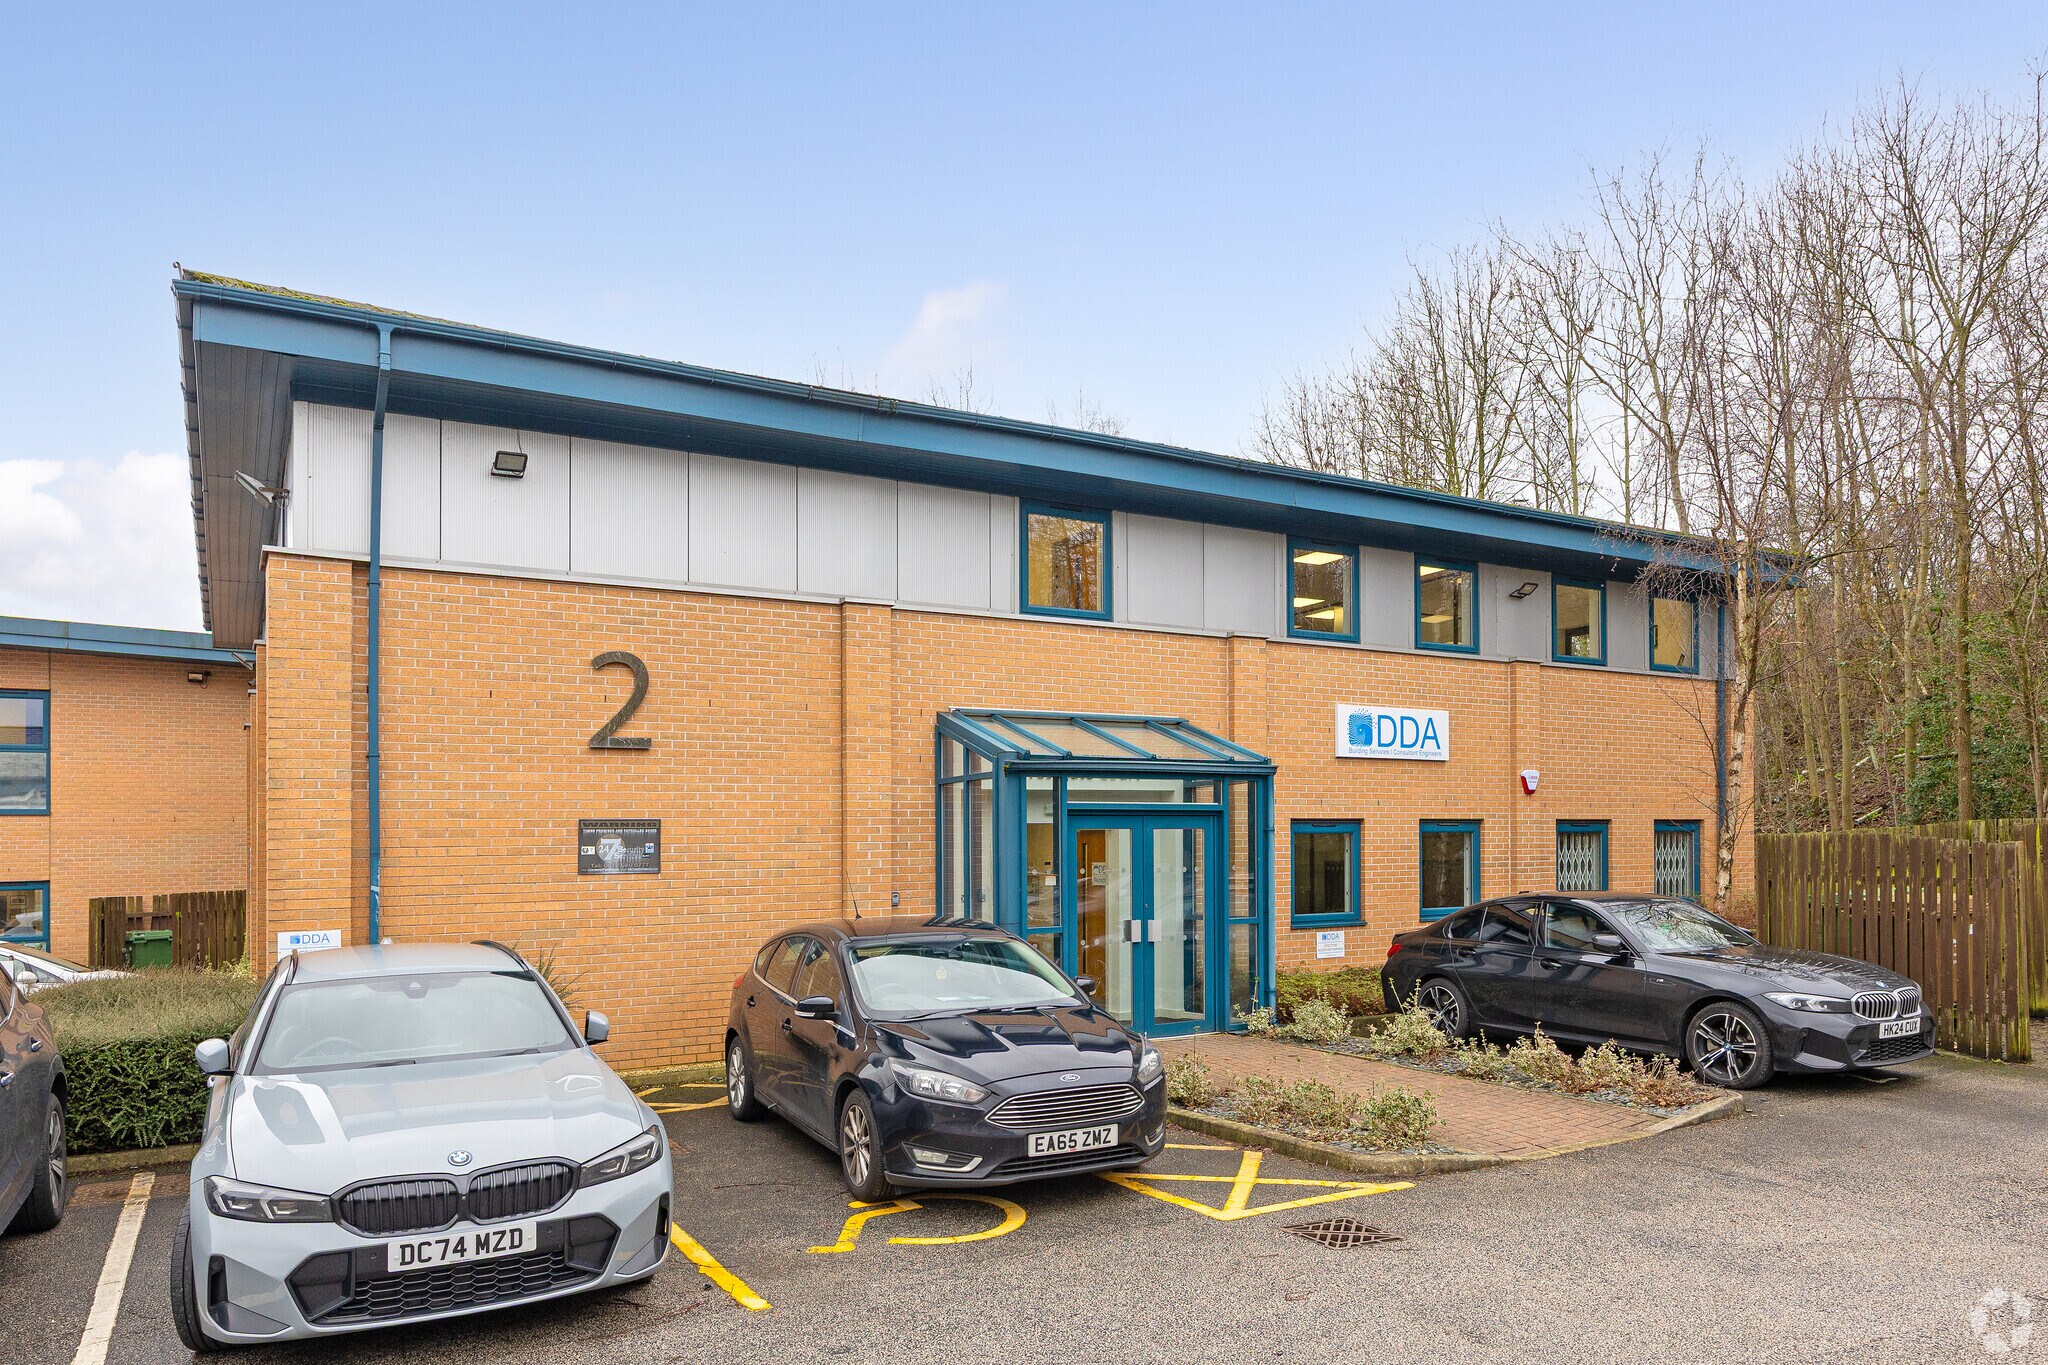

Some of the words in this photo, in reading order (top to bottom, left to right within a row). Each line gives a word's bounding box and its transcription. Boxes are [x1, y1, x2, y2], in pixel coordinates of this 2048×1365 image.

[590, 650, 652, 749] 2
[1377, 714, 1441, 750] DDA
[1348, 747, 1369, 756] Building
[1393, 748, 1418, 756] Consultant
[302, 933, 330, 944] DDA
[1883, 1022, 1904, 1036] HK24
[1904, 1020, 1918, 1033] CUX
[1034, 1132, 1078, 1153] EA65
[1082, 1128, 1112, 1148] ZMZ
[400, 1236, 467, 1266] DC74
[475, 1227, 523, 1255] MZD
